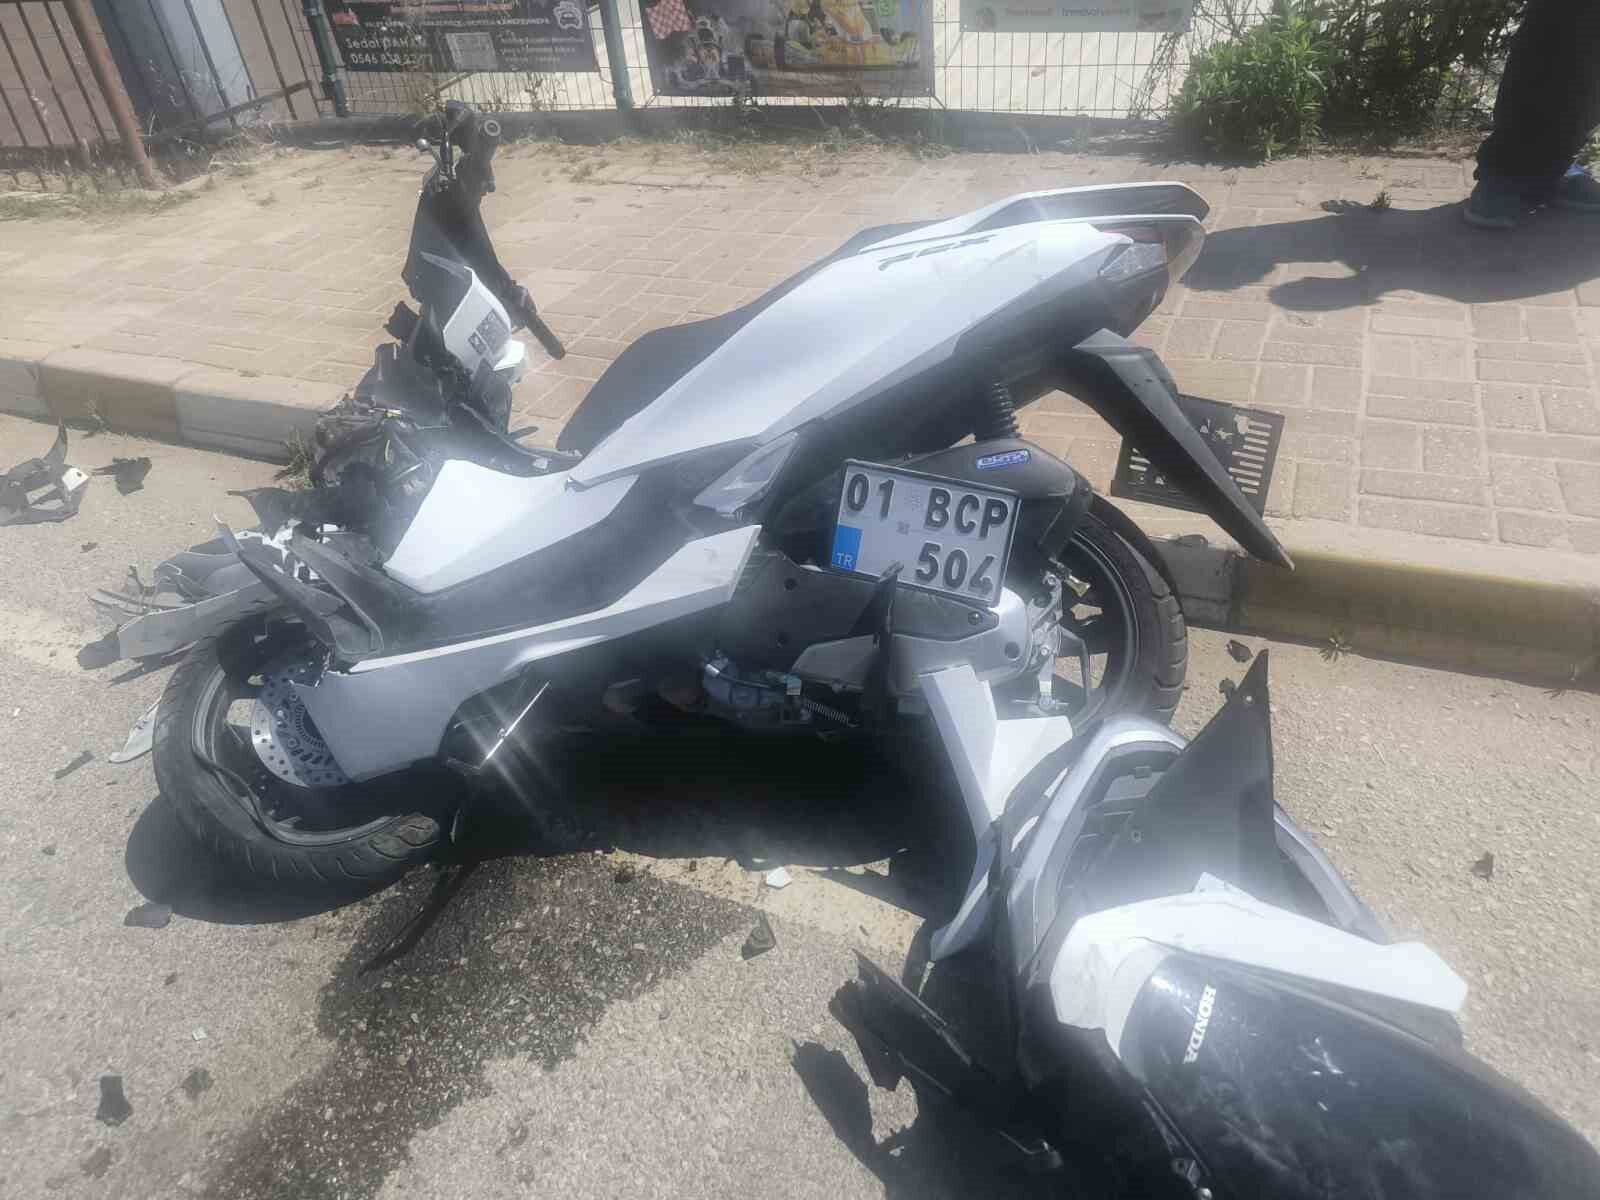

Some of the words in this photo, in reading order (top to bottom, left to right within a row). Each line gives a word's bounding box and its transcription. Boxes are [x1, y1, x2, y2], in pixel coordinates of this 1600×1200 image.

[847, 473, 895, 520] 01
[923, 487, 1009, 540] BCP
[836, 552, 853, 568] TR
[914, 541, 996, 593] 504
[1183, 983, 1217, 1065] HONDA
